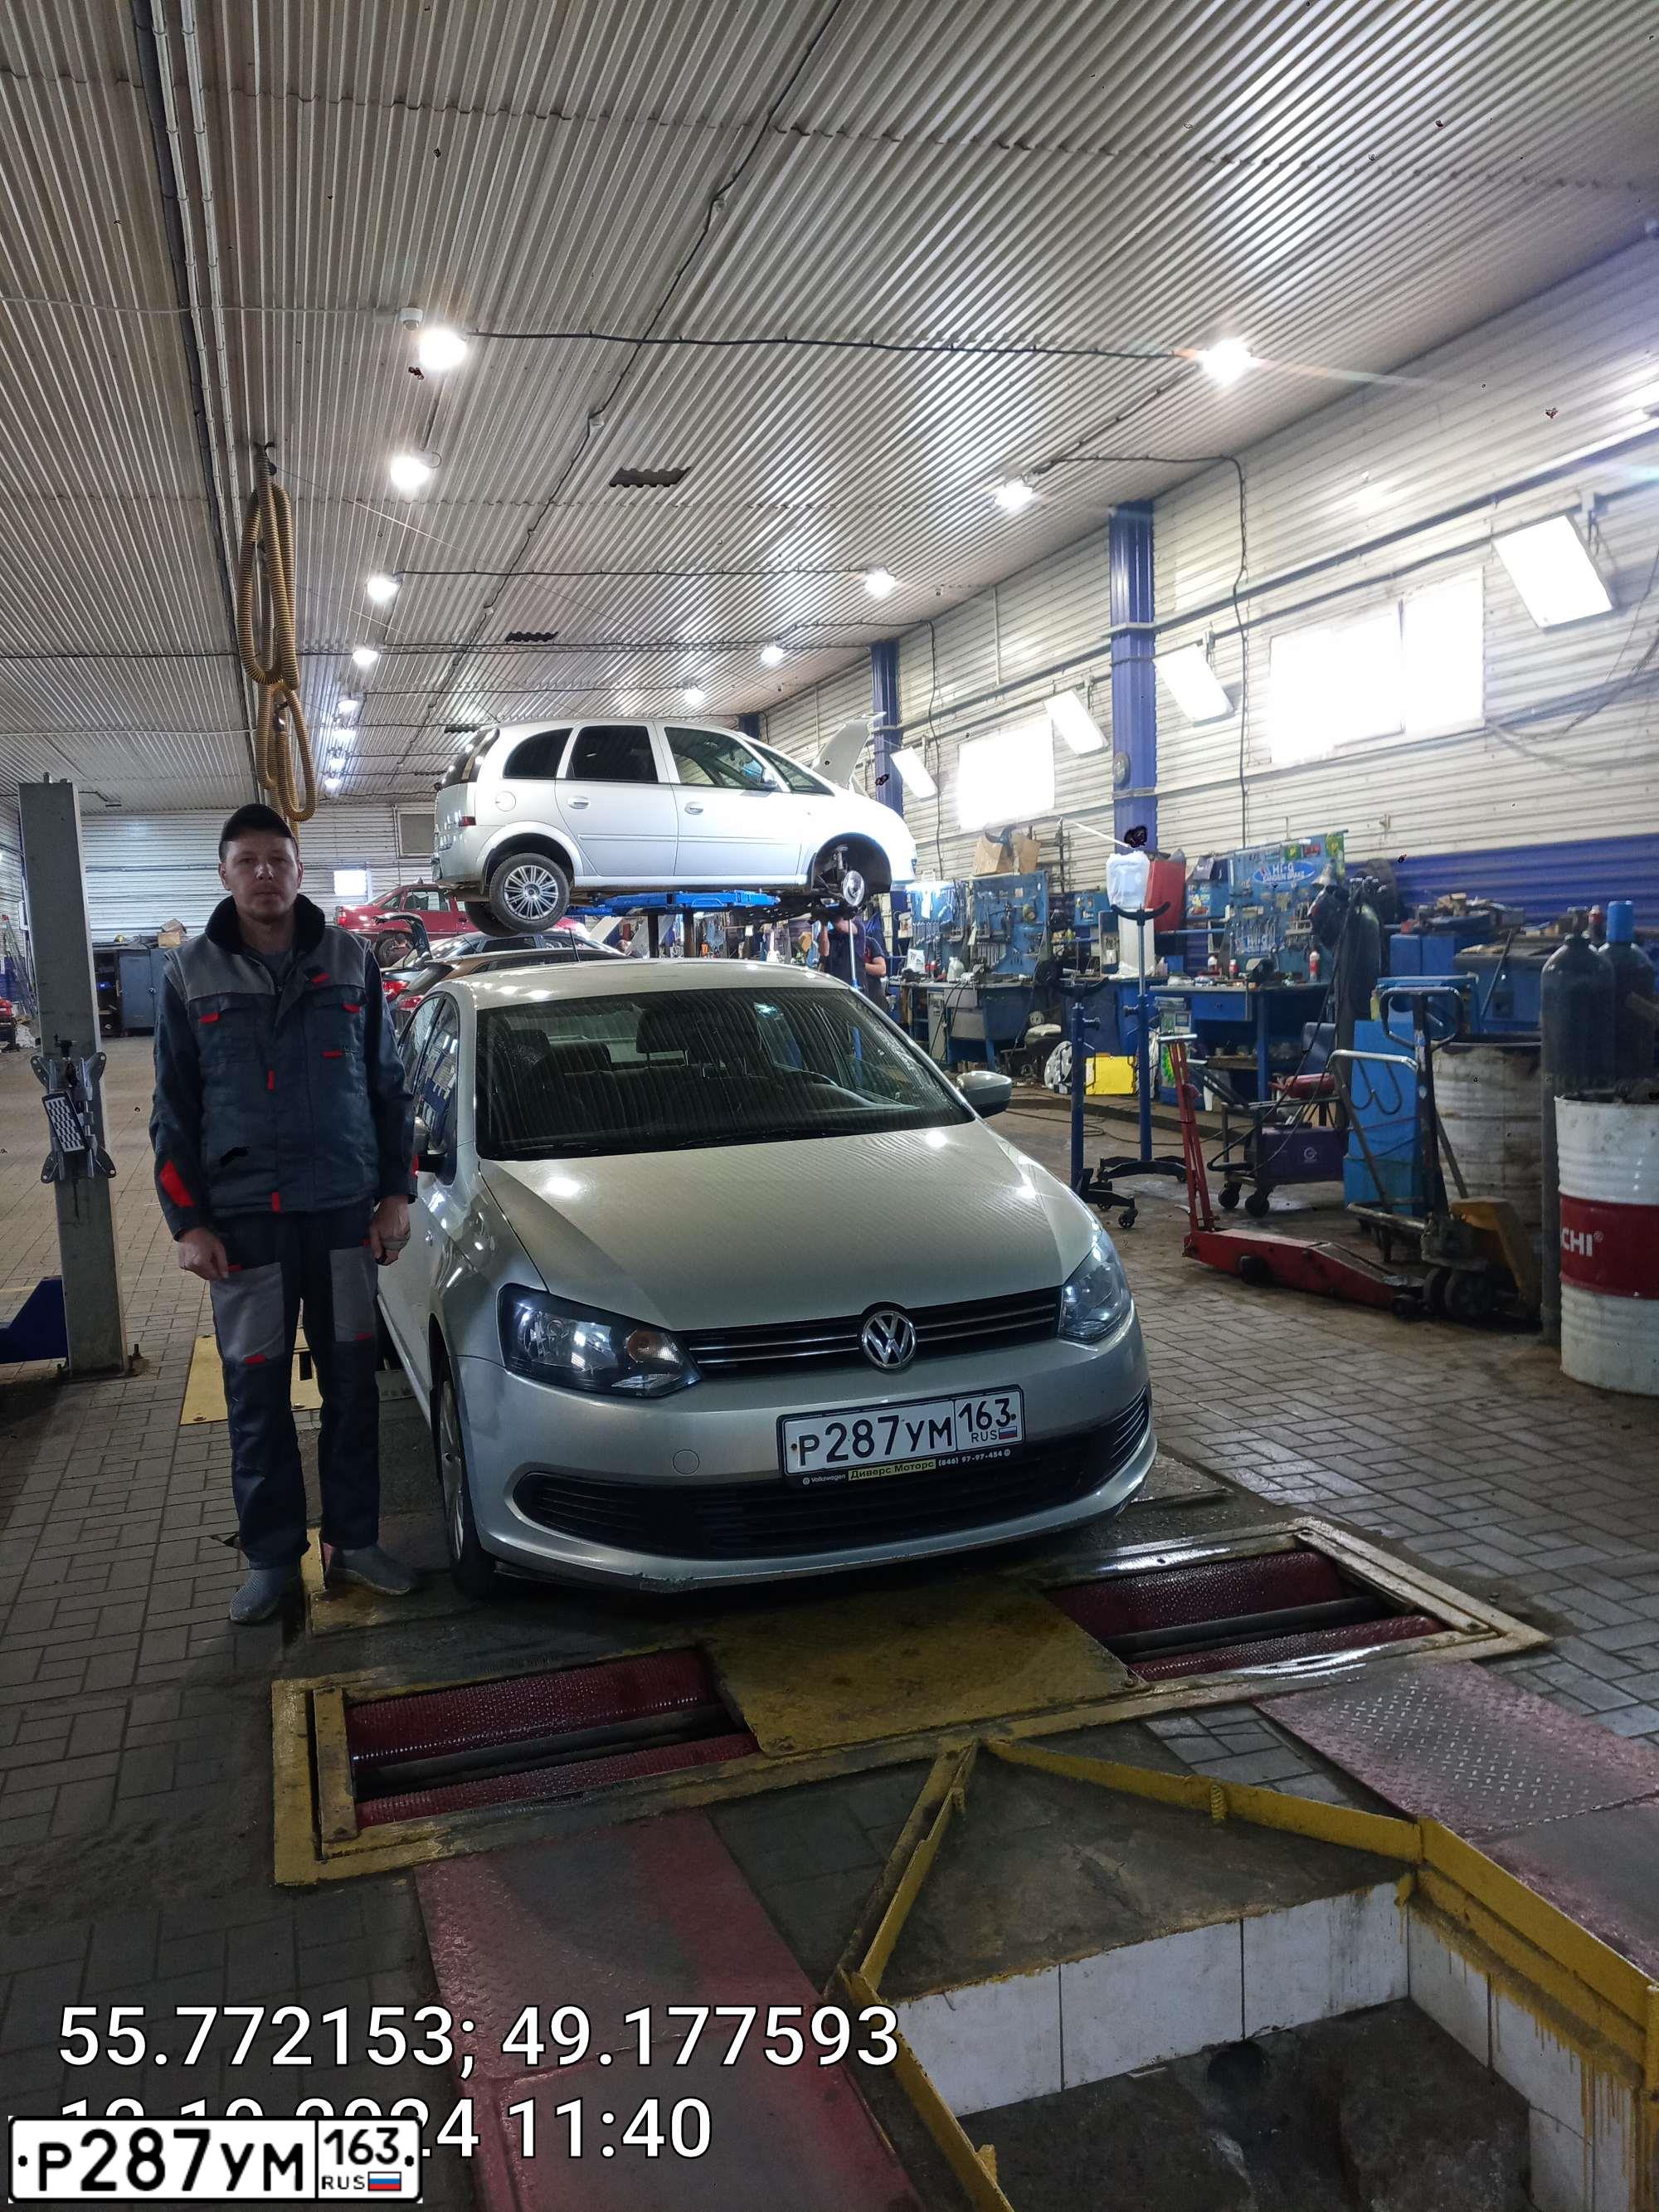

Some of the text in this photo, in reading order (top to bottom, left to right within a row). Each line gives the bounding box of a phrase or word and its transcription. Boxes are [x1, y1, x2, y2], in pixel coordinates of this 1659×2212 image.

[799, 1398, 1010, 1466] Р287УМ 163
[971, 1431, 998, 1443] RUS
[850, 1467, 892, 1479] Диверс
[894, 1461, 934, 1473] Моторс
